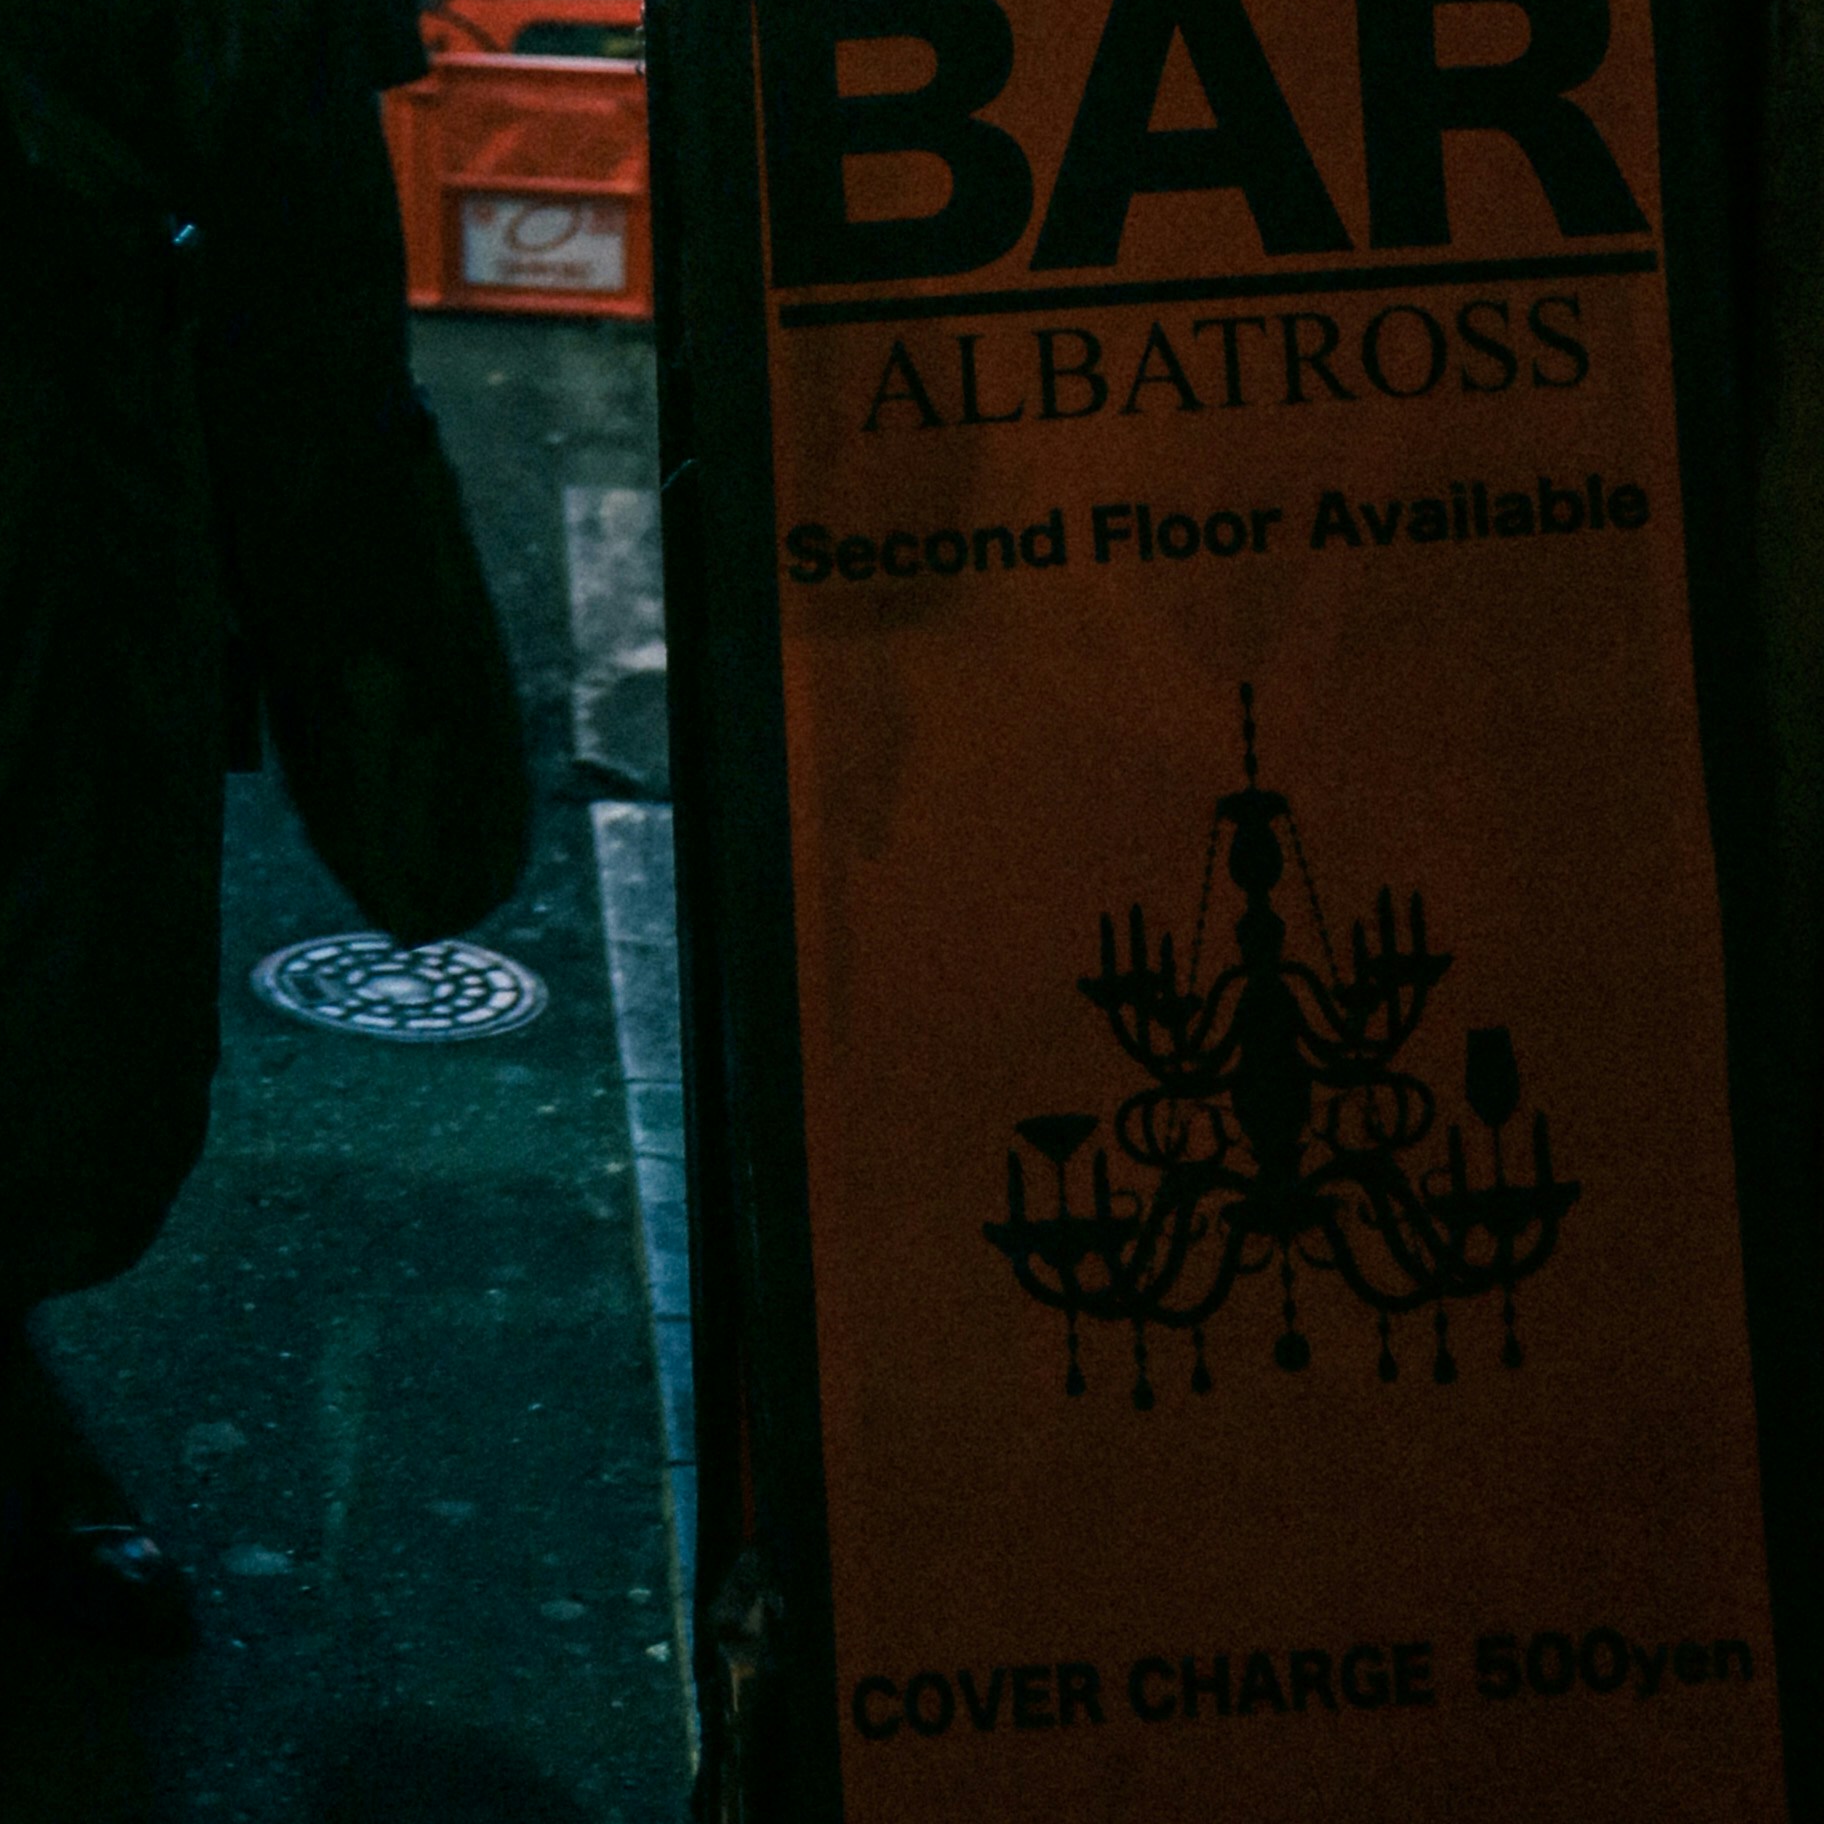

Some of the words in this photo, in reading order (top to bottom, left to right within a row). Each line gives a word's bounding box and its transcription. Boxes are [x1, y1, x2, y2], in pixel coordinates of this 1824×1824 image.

[861, 293, 1592, 433] ALBATROSS
[785, 506, 1066, 585] Second
[1091, 499, 1281, 564] Floor
[1309, 474, 1651, 550] Available
[852, 1662, 1105, 1741] COVER
[1127, 1642, 1435, 1721] CHARGE
[1474, 1628, 1756, 1708] 500yen
